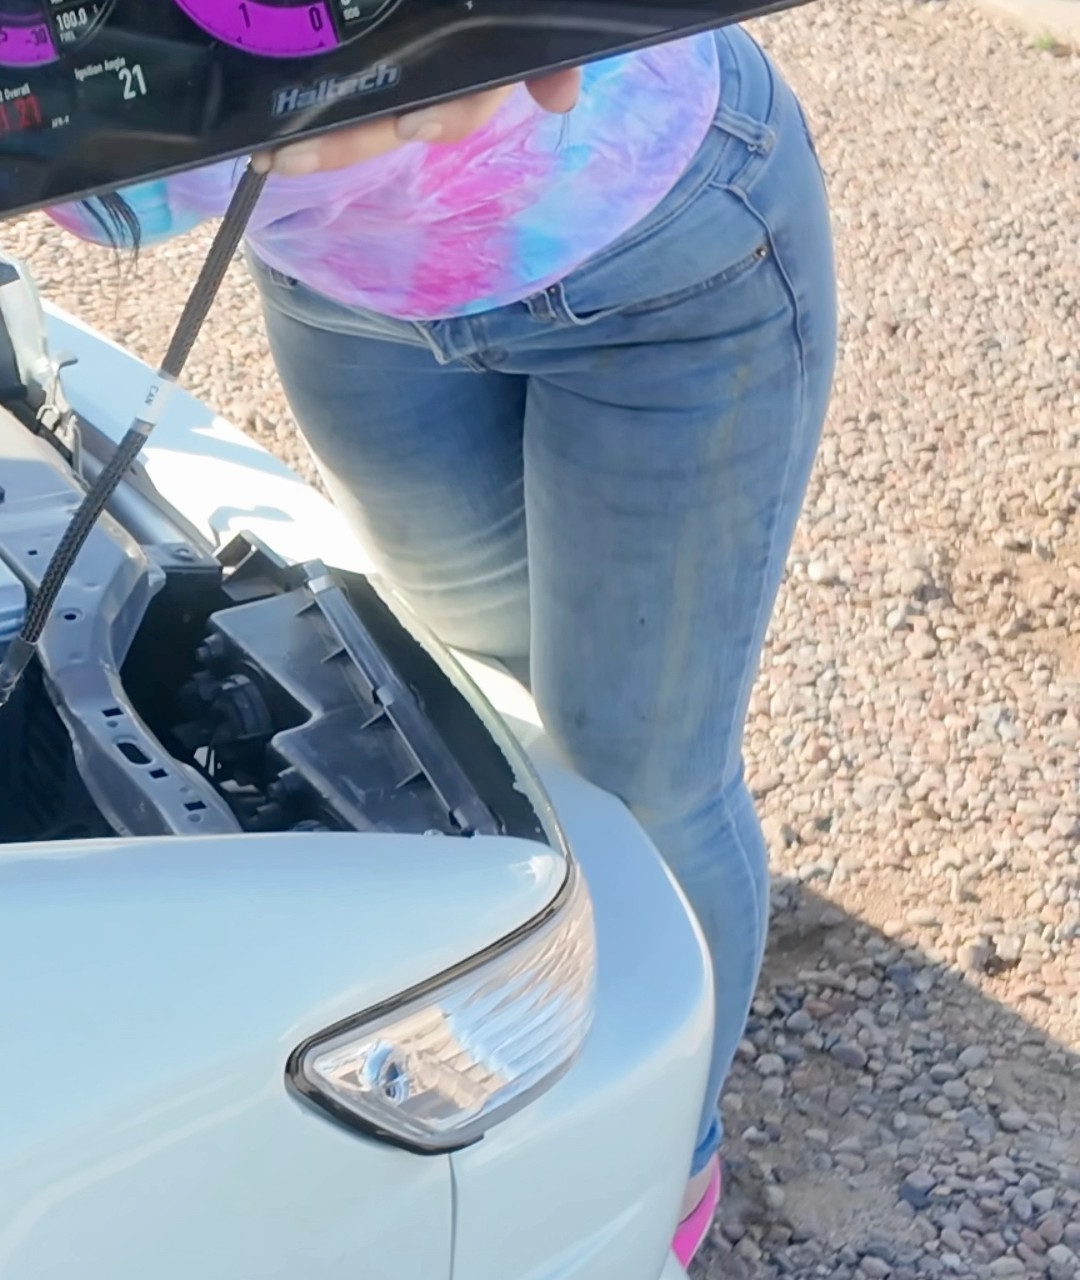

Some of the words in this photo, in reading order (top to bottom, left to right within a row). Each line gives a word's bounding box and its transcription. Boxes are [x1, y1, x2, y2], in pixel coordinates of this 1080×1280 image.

[56, 7, 88, 31] 100.0
[238, 2, 251, 29] 1
[308, 6, 323, 32] 0
[25, 27, 47, 46] -30
[118, 64, 147, 100] 21
[276, 64, 397, 115] Haltech
